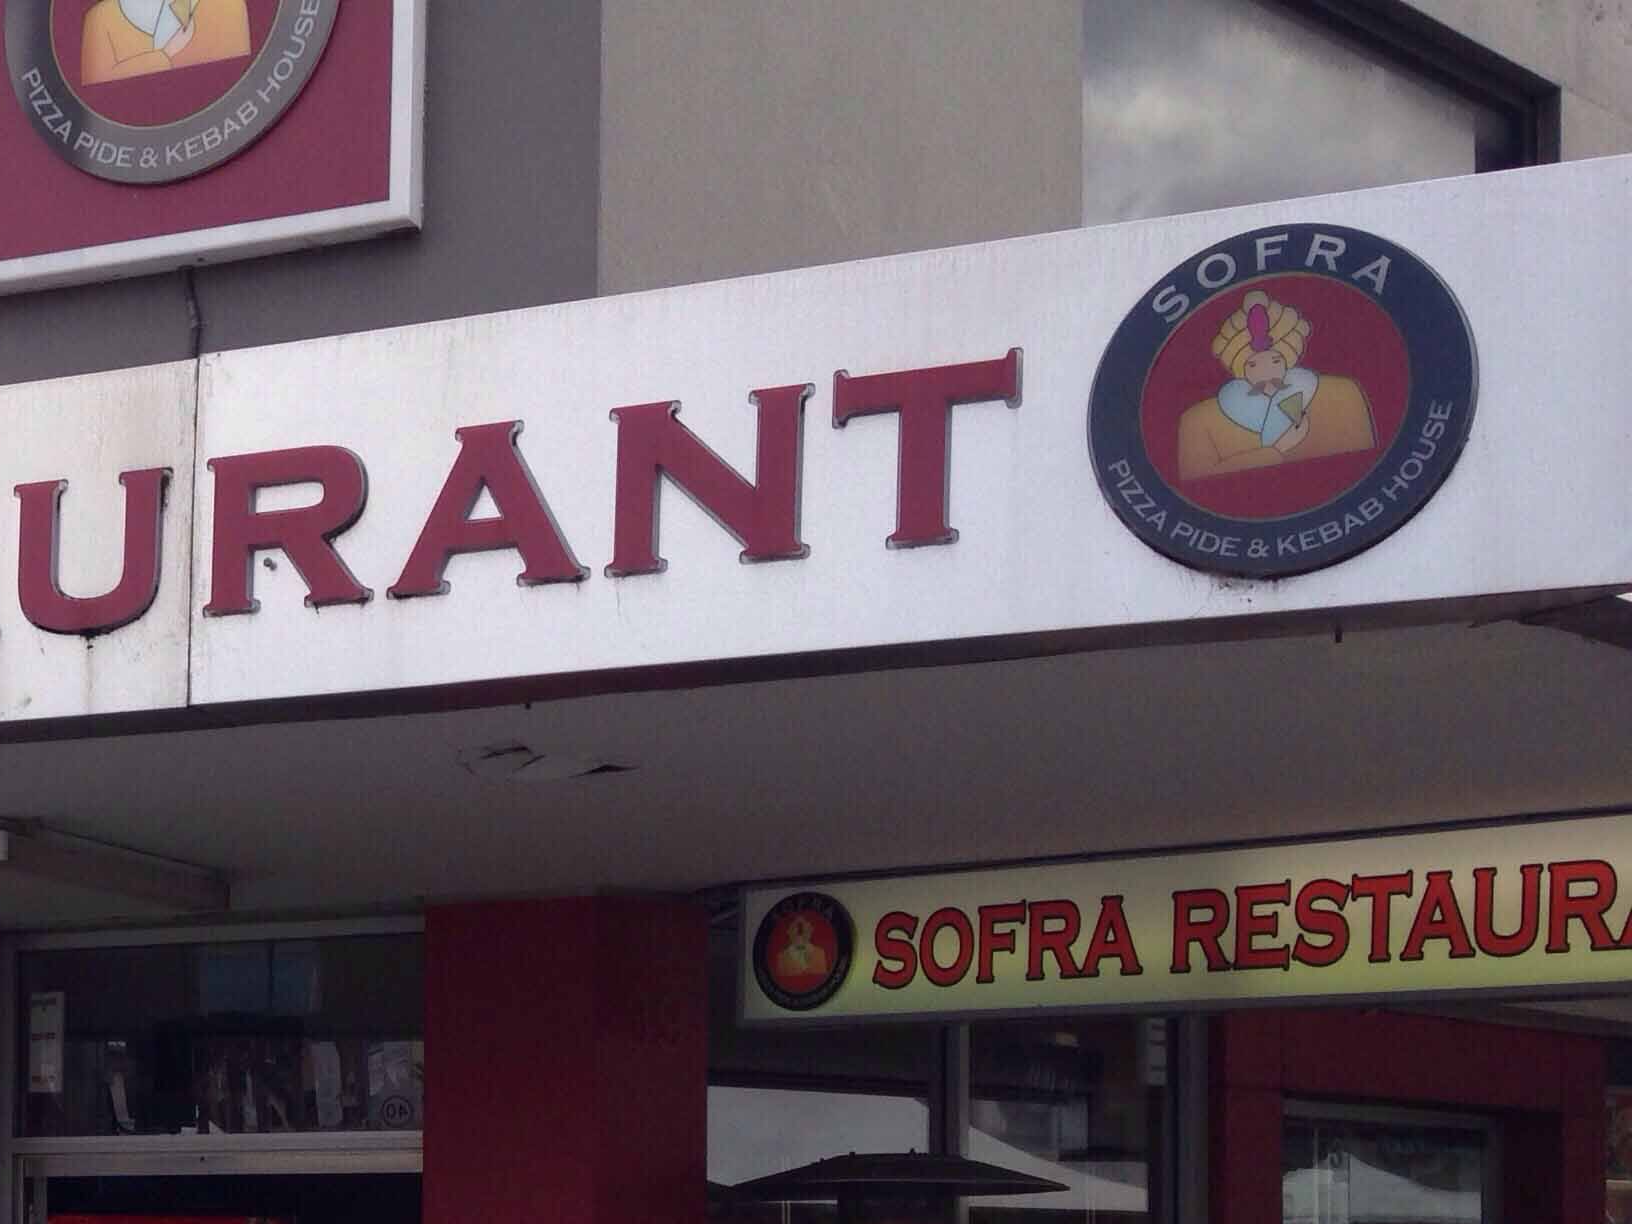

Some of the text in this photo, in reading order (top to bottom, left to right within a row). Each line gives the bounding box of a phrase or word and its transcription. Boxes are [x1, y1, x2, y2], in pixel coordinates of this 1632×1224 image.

[21, 0, 320, 169] PIZZA PIDE & KEBAB HOUSE
[1152, 232, 1392, 323] SOFRA
[1108, 400, 1453, 557] PIZZA PIDE & KEBAB HOUSE
[873, 895, 1143, 989] SOFRA
